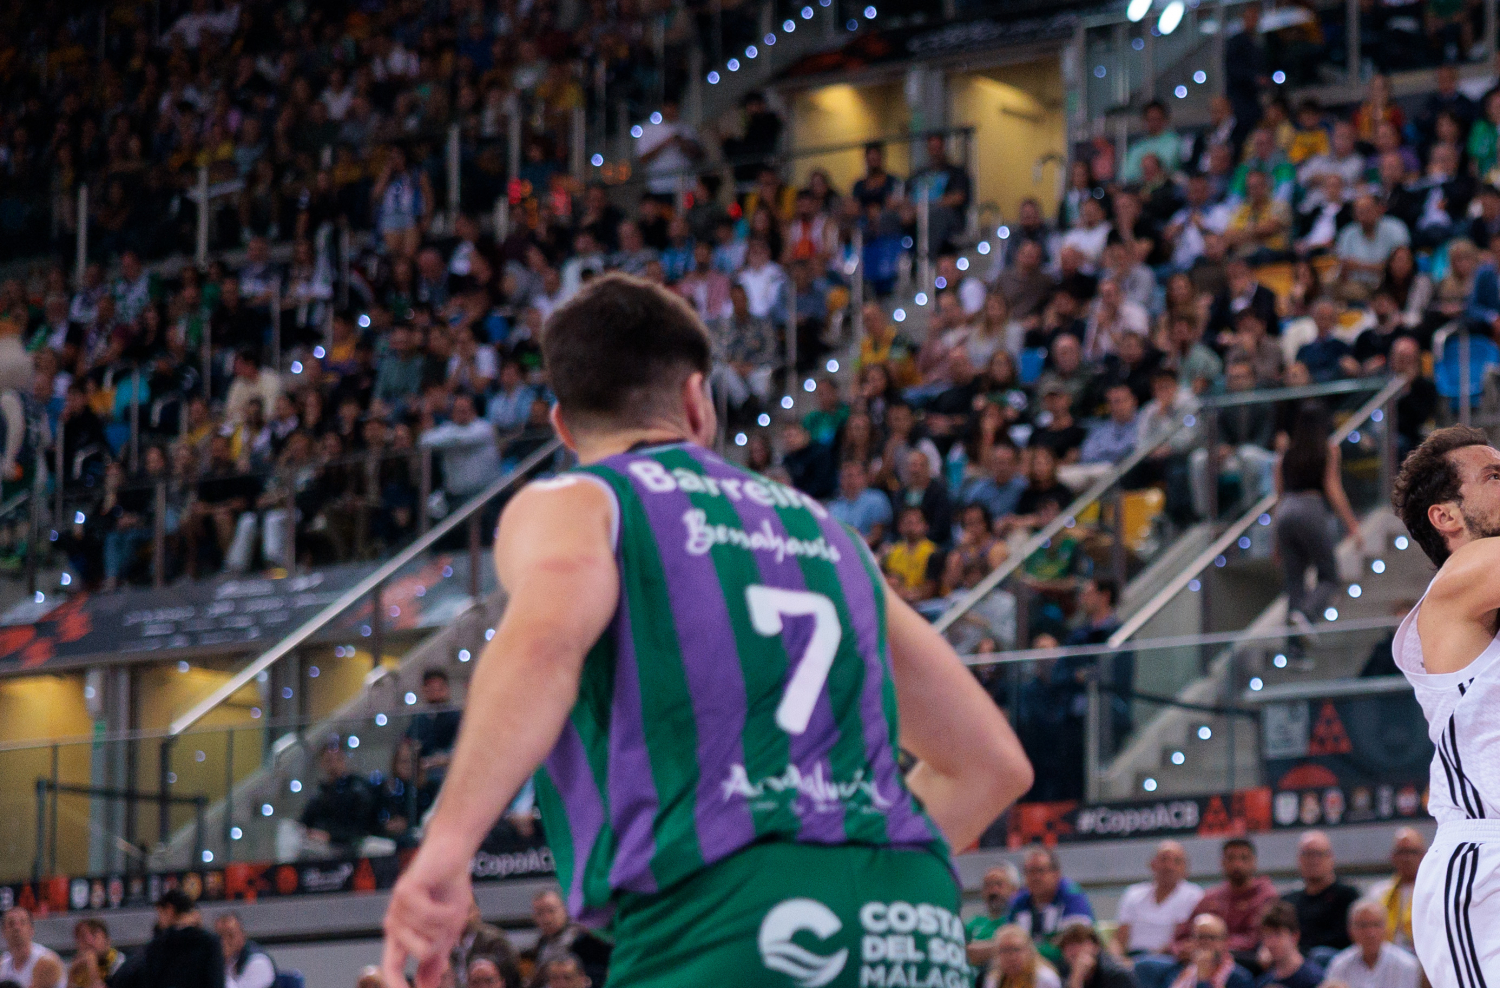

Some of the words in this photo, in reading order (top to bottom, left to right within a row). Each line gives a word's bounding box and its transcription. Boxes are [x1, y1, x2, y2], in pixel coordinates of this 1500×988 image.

[745, 584, 842, 736] 7
[859, 900, 966, 946] COSTA
[861, 934, 925, 964] DEL
